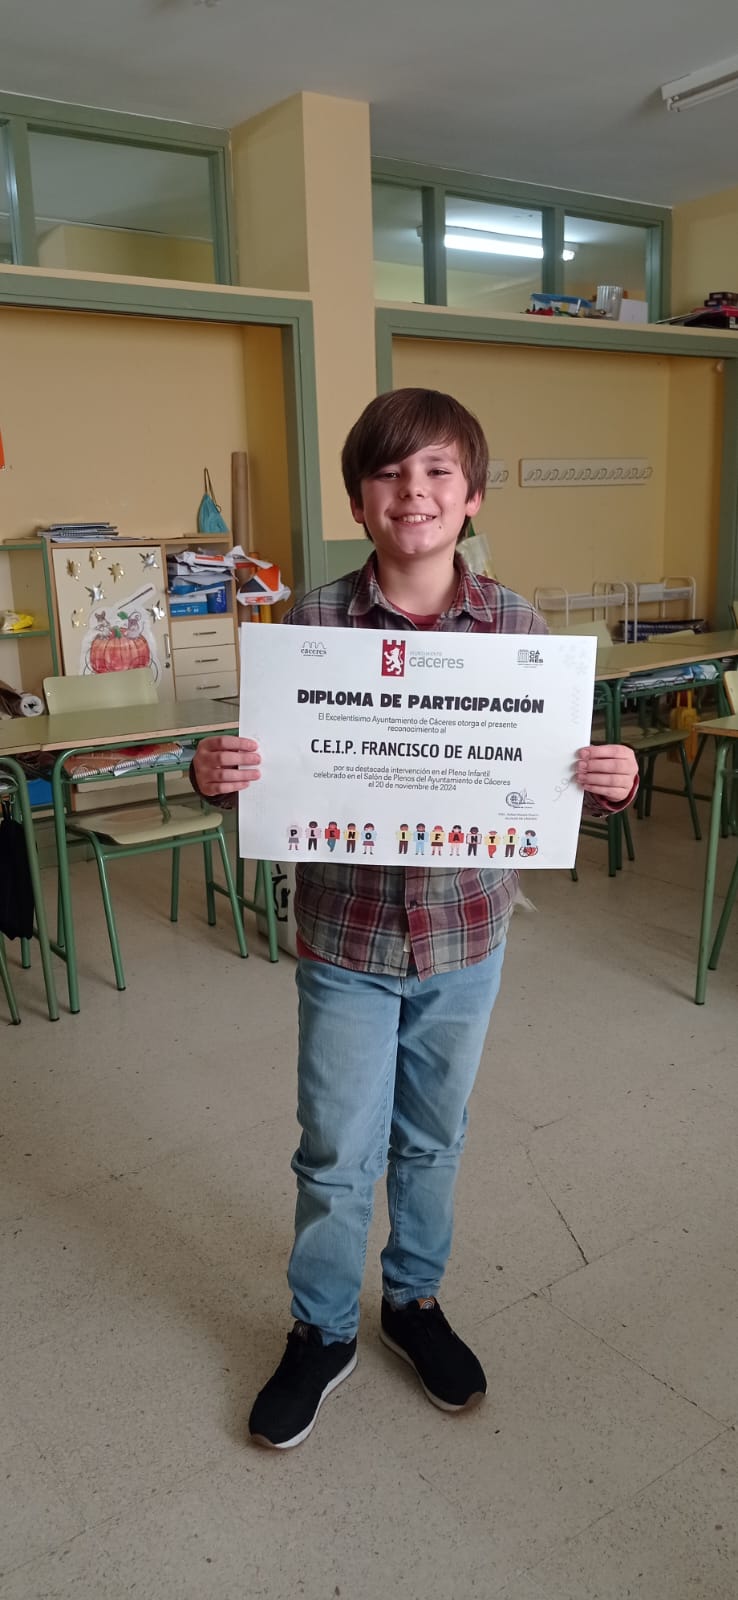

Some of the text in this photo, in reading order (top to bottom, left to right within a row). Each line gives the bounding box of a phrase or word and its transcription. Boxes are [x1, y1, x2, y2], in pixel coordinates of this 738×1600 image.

[297, 689, 544, 713] DIPLOMA DE PARTICIPACIÓN
[318, 713, 324, 721] El
[372, 716, 418, 725] Ayuntamiento
[429, 718, 456, 726] Cáceres
[457, 720, 479, 728] otorga
[387, 725, 439, 733] reconocimiento
[311, 739, 522, 761] C.E.I.P. FRANCISCO DE ALDANA
[313, 771, 346, 779] celebrado
[393, 773, 415, 782] Plenos
[416, 775, 427, 783] del
[427, 776, 473, 784] Ayuntamiento
[483, 777, 511, 786] Cáceres
[355, 765, 389, 773] destacada
[390, 767, 430, 775] intervención
[468, 769, 491, 777] Infantil
[394, 782, 429, 790] noviembre
[440, 783, 457, 791] 2024
[290, 829, 532, 846] PLENO INFANTIL
